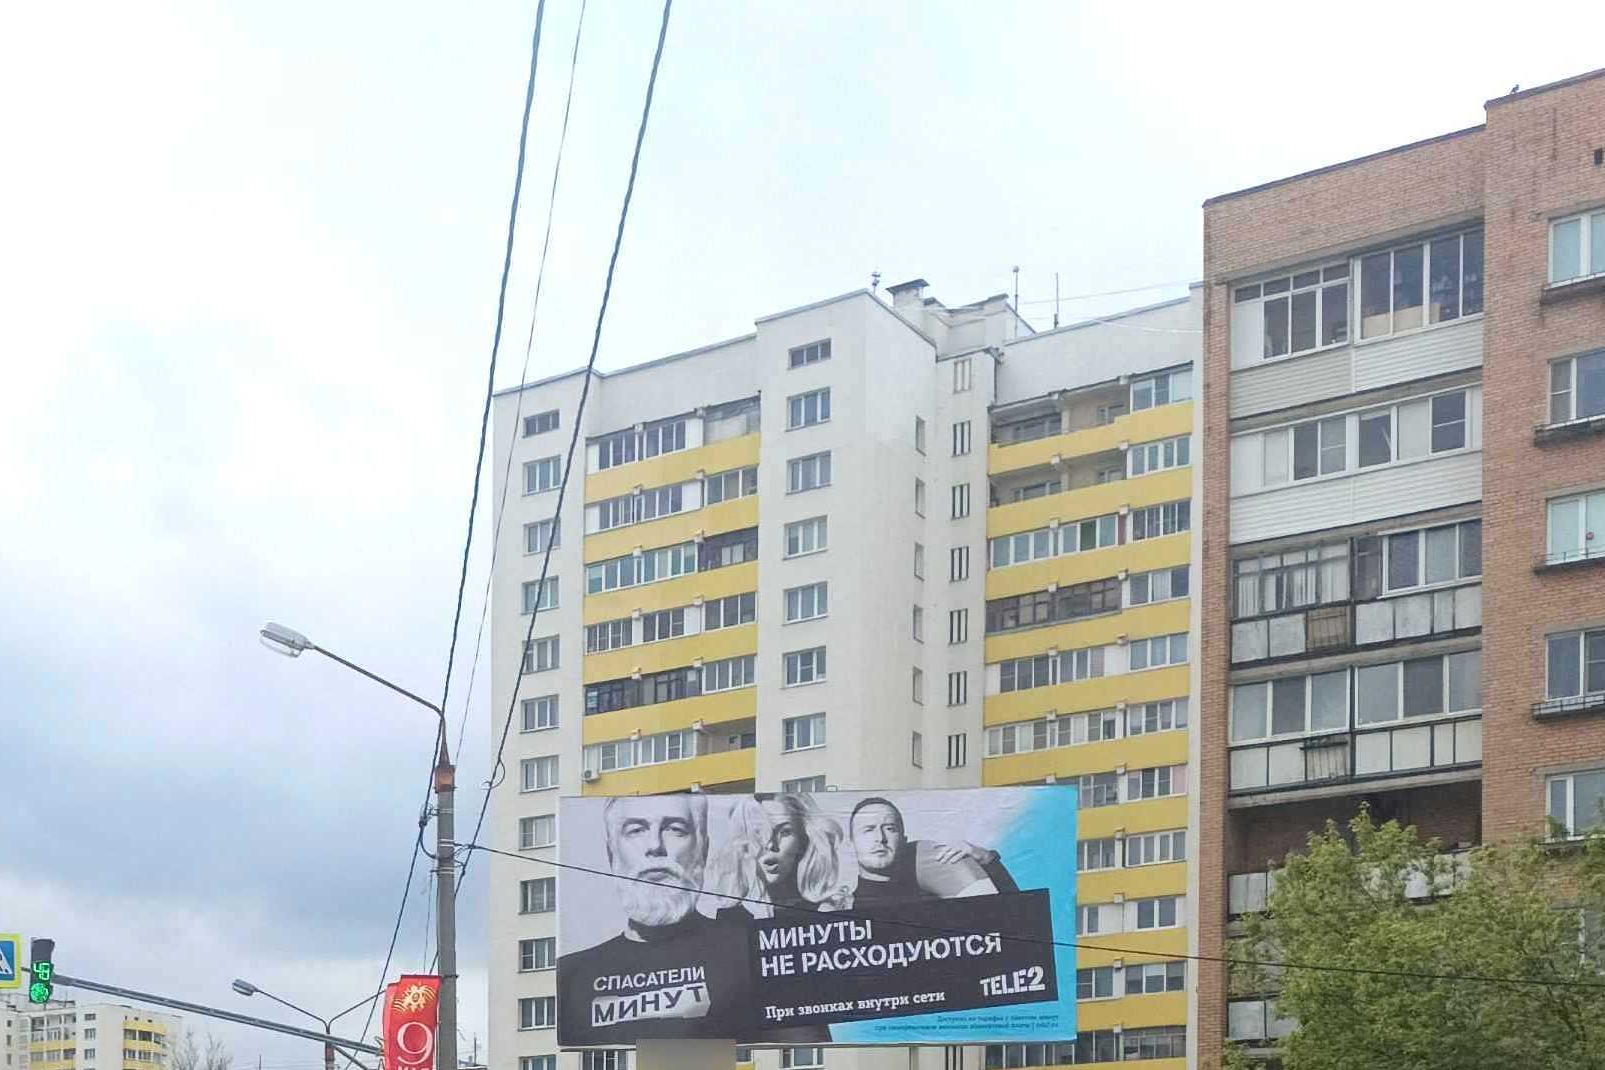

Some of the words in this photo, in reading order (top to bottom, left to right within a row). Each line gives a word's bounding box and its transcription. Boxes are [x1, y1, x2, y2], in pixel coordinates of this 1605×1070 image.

[759, 920, 872, 950] МИНУТЫ
[761, 953, 795, 977] НЕ
[801, 932, 1002, 973] РАСХОДУЮТСЯ
[593, 966, 706, 992] СПАСАТЕЛИ
[980, 965, 1046, 997] TELE2
[594, 985, 705, 1024] МИНУТ
[765, 1005, 795, 1020] При
[798, 1001, 854, 1018] звонках
[857, 994, 910, 1013] внутри
[913, 990, 946, 1004] сети
[396, 1021, 434, 1065] 9
